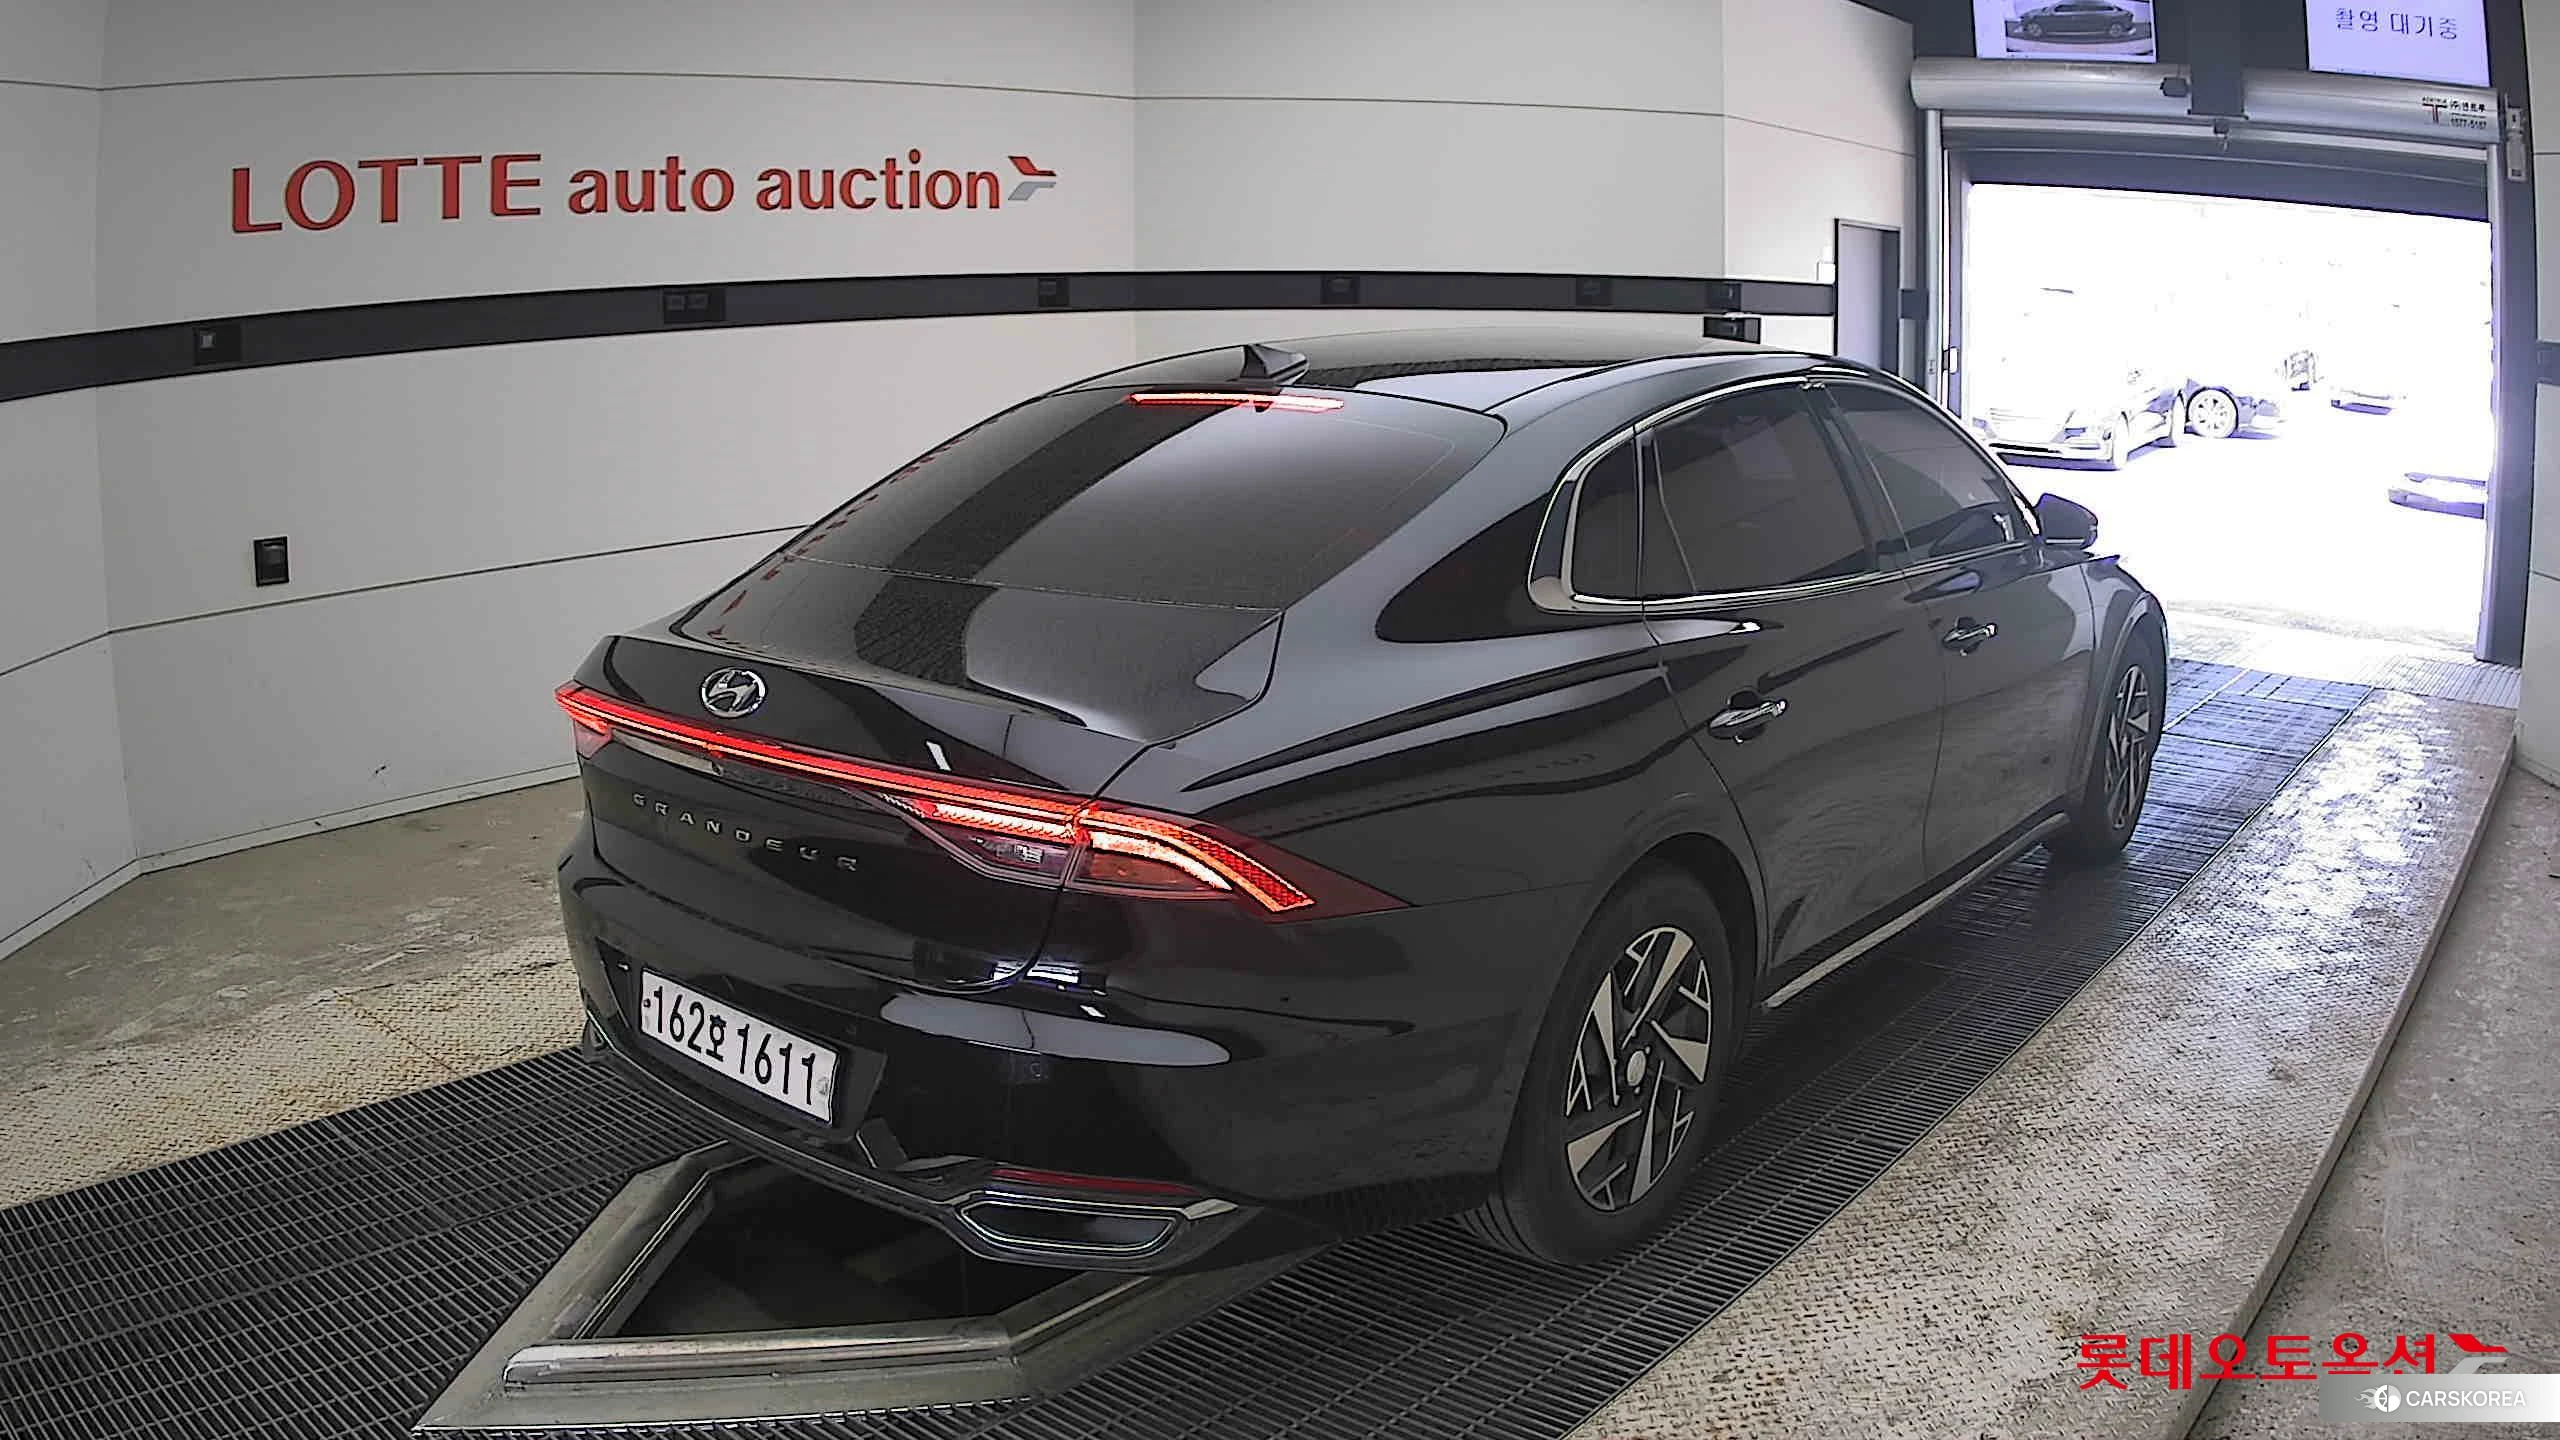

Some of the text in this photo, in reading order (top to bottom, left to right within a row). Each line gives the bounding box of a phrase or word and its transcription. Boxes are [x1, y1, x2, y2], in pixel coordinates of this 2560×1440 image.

[2336, 8, 2457, 40] 촬영 대기 중
[232, 148, 1000, 233] LOTTE auto auction
[632, 793, 857, 872] GRANDEUR
